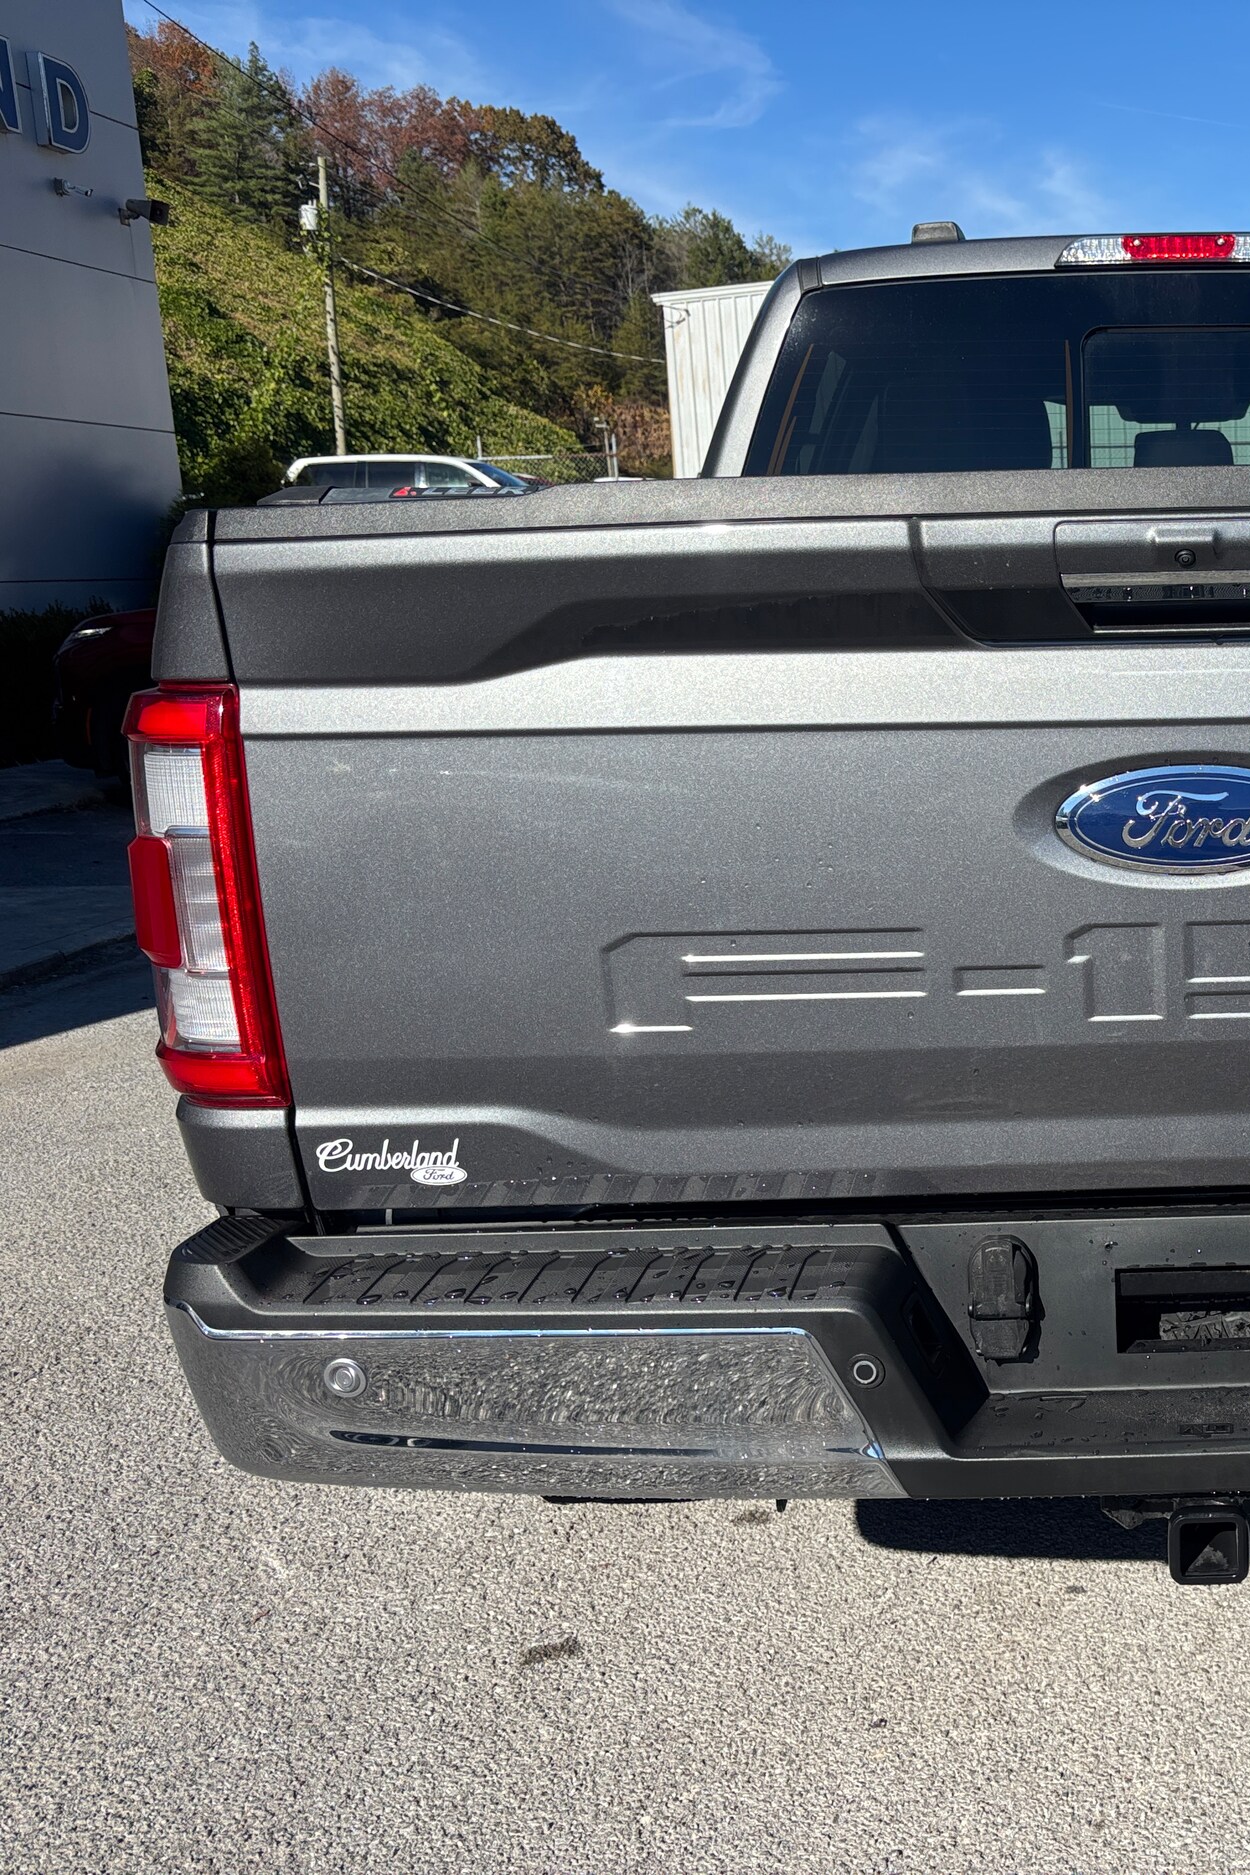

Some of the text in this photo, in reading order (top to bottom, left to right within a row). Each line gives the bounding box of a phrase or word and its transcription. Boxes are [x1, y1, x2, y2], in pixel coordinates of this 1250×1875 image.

[421, 486, 527, 496] LEER
[315, 1138, 460, 1173] Cumberland
[422, 1168, 455, 1181] Ford
